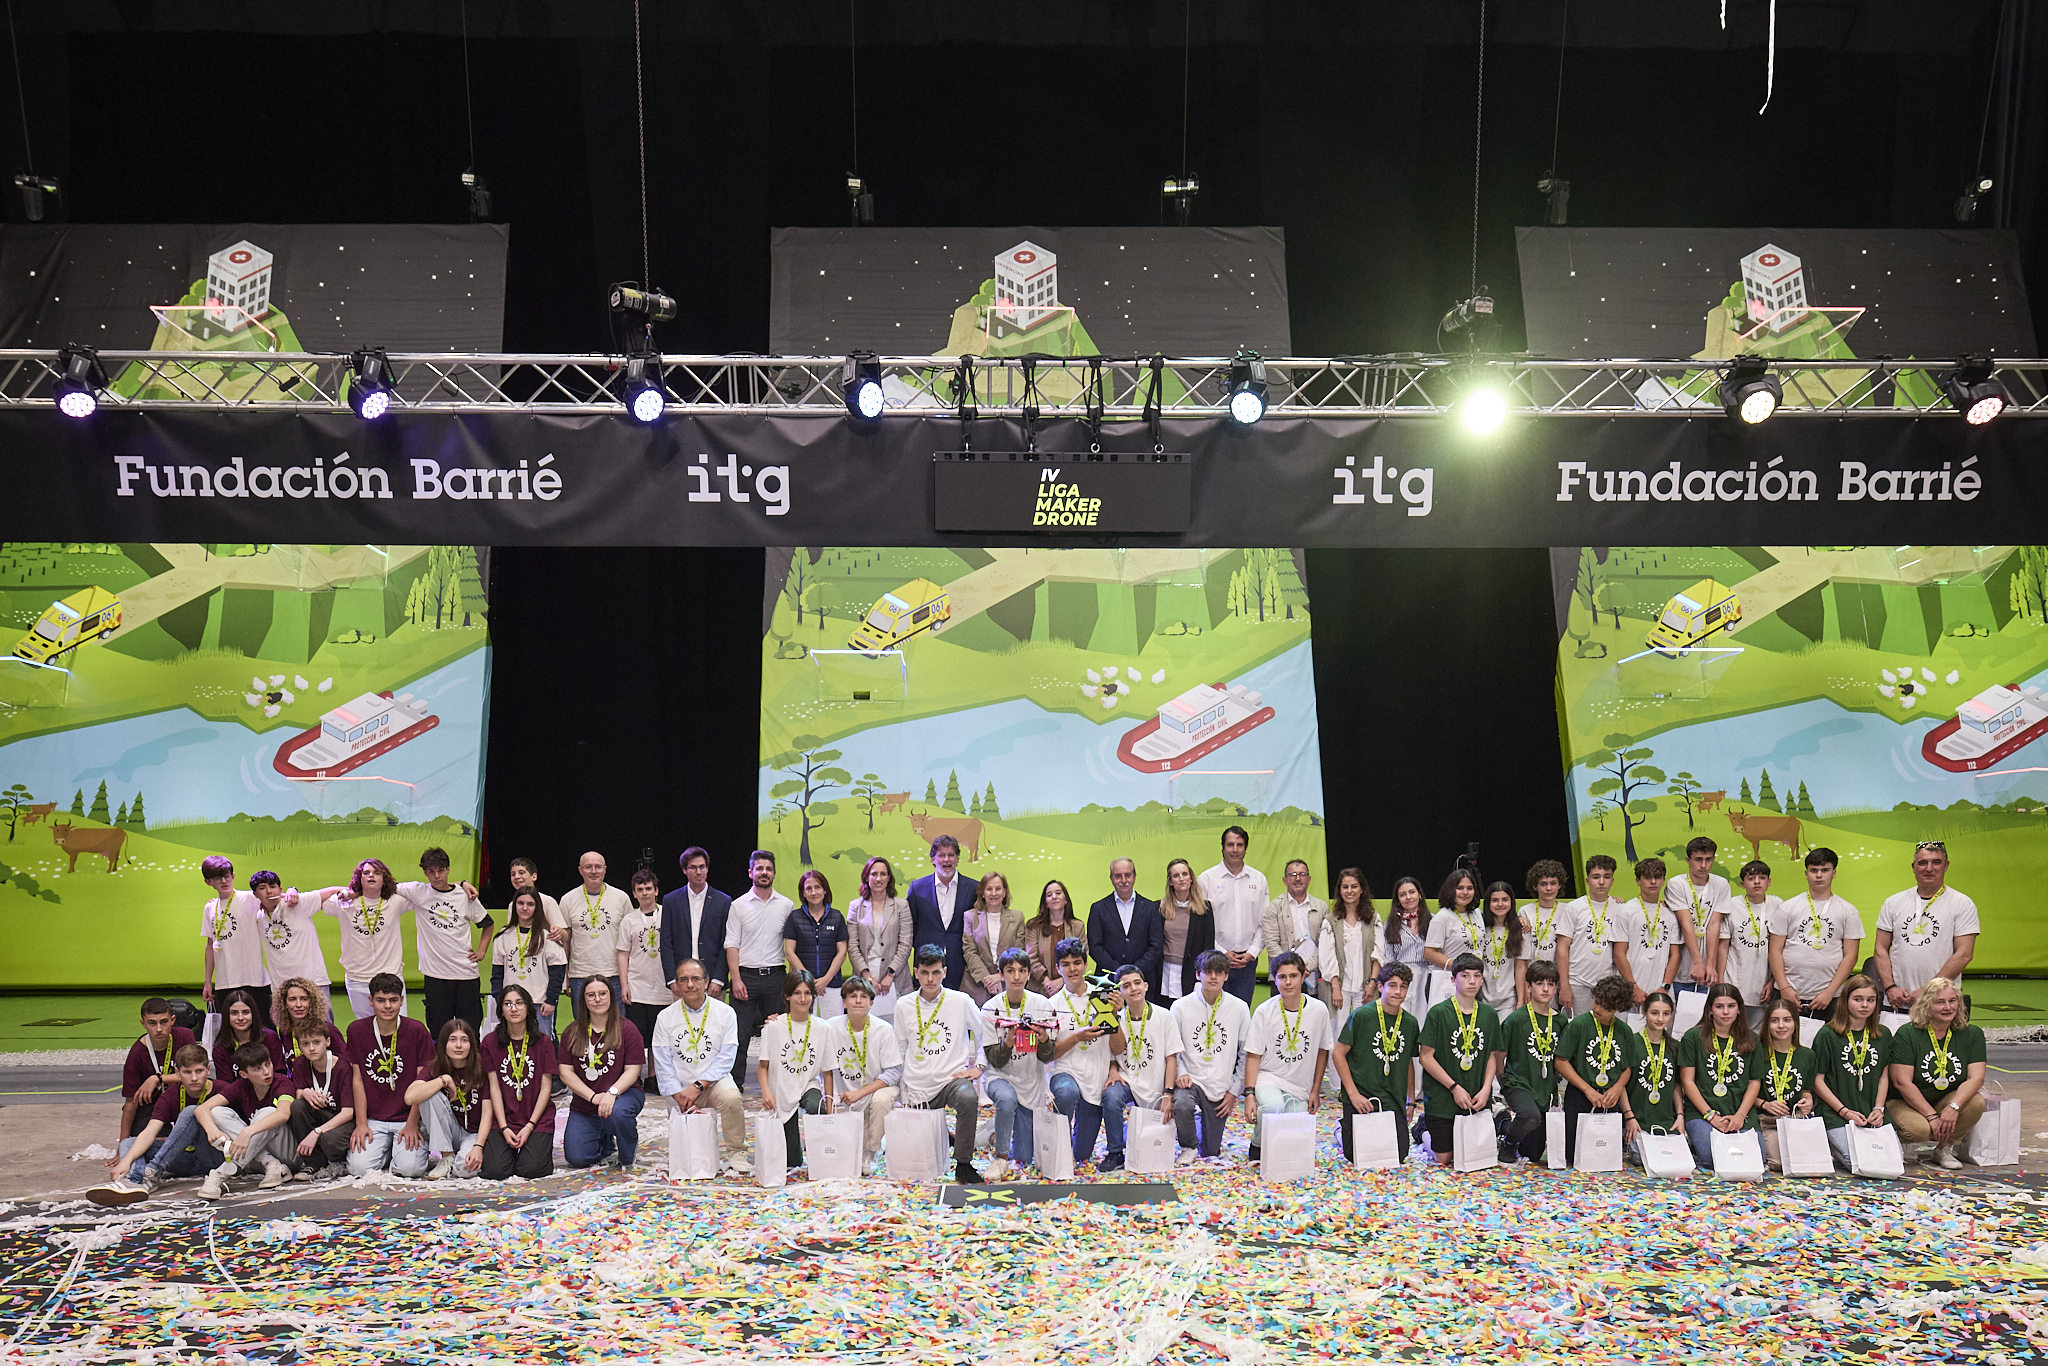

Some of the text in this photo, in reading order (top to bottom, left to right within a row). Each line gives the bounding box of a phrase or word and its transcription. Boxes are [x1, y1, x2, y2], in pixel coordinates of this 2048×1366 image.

[114, 451, 563, 501] Fundación Barrié
[1040, 468, 1061, 483] IV
[1556, 455, 1982, 502] Fundación Barrié
[1038, 483, 1080, 498] LIGA
[1035, 497, 1102, 512] MAKER
[1032, 511, 1099, 526] DRONE
[888, 604, 902, 615] 061
[931, 600, 944, 614] 061
[1680, 605, 1694, 616] 061
[1722, 600, 1735, 615] 061
[101, 608, 115, 622] 061
[1218, 717, 1228, 728] CIVIL
[2016, 718, 2026, 728] CIVIL
[380, 726, 390, 738] CIVIL
[1161, 762, 1171, 770] 112
[1967, 761, 1977, 770] 112
[443, 902, 459, 922] MAKER
[273, 920, 292, 938] MAKER
[430, 916, 453, 929] DRONE
[580, 923, 606, 931] DNE
[1586, 920, 1594, 932] LIG
[1799, 916, 1813, 932] LIGA
[1922, 912, 1940, 938] MAKER
[1483, 954, 1506, 966] DONE
[508, 964, 532, 973] DNE
[1192, 1022, 1206, 1040] LIGA
[1372, 1030, 1383, 1046] LIG
[674, 1030, 689, 1047] LIGA
[1194, 1042, 1222, 1054] DNE
[1452, 1047, 1478, 1060] DRNE
[365, 1048, 380, 1067] LIGA
[675, 1050, 706, 1063] DONE
[1706, 1053, 1717, 1068] LIG
[838, 1068, 862, 1080] DRON
[1921, 1050, 1962, 1084] LIGA AKER DNE
[1708, 1070, 1738, 1084] DRNE
[1638, 1077, 1665, 1092] DONE
